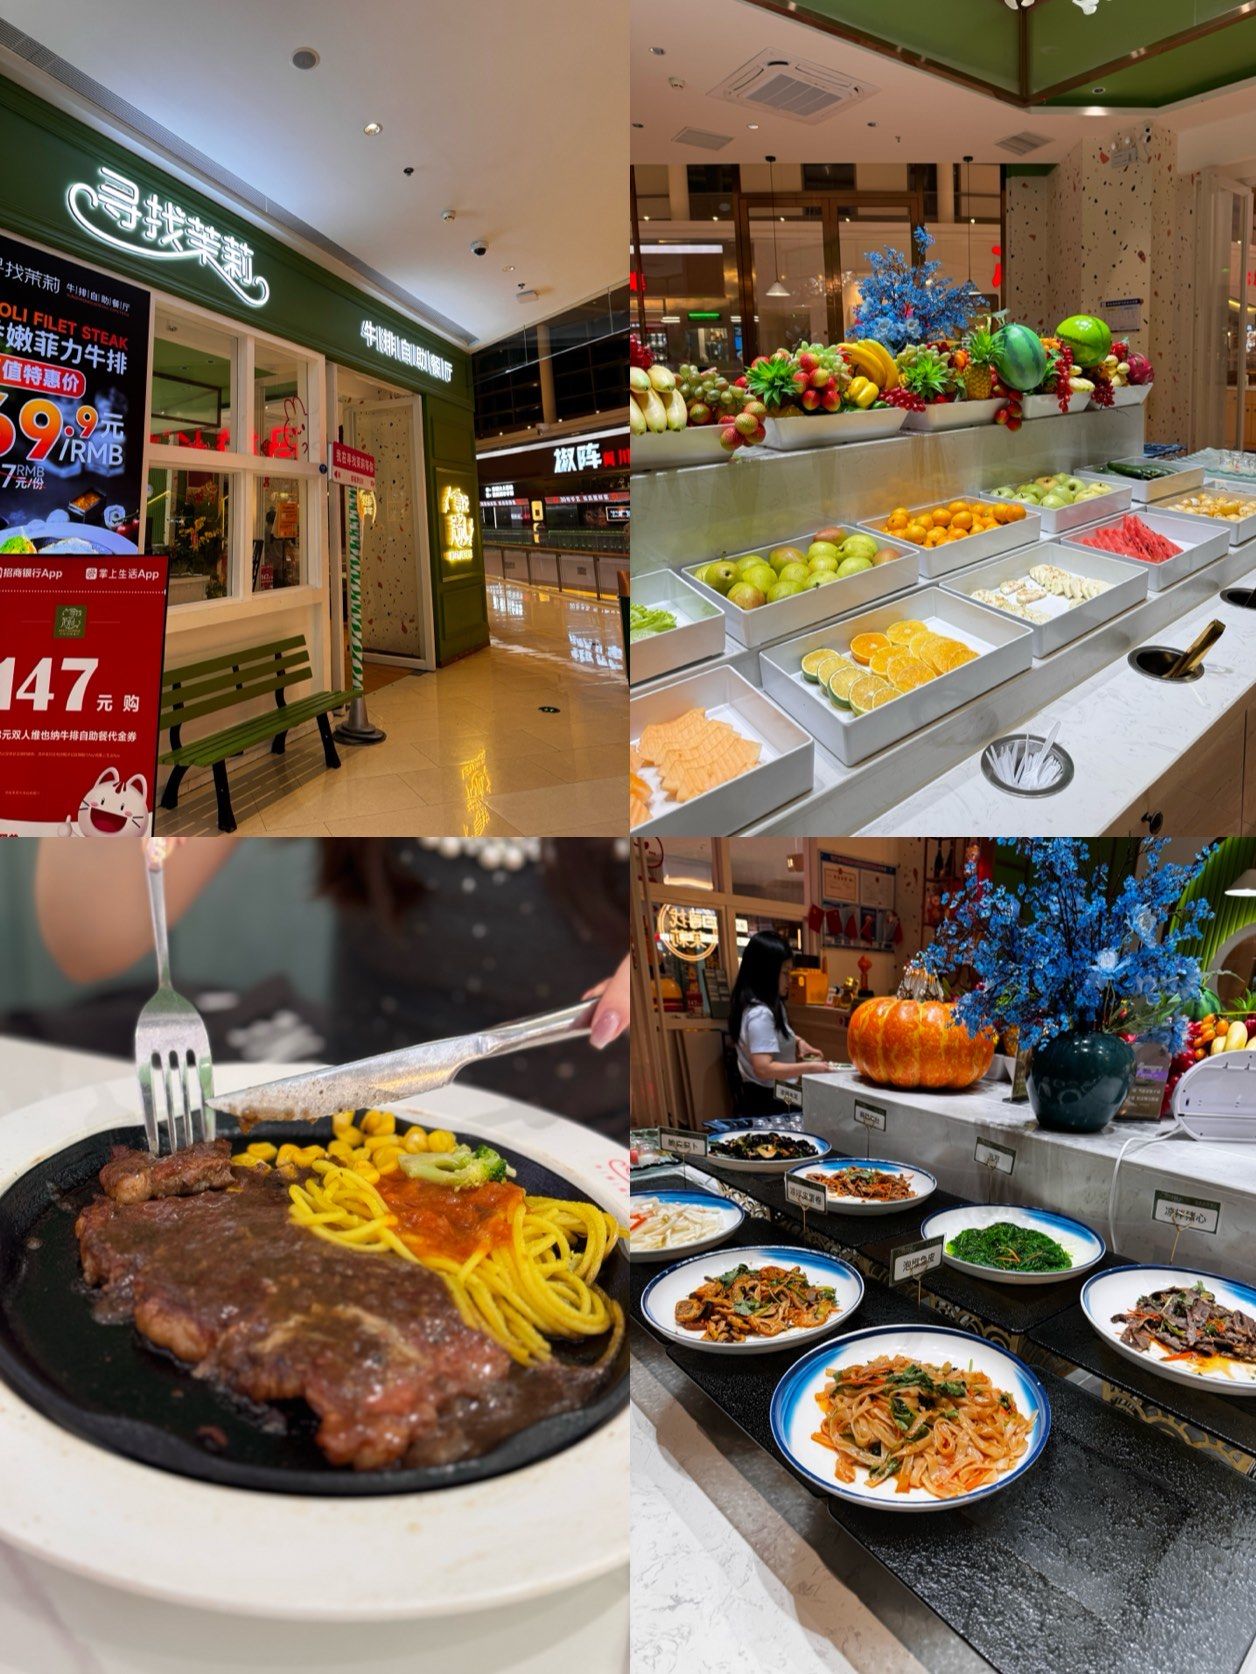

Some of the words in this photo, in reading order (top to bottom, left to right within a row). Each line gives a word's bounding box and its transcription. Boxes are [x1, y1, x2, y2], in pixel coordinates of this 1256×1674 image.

[90, 166, 257, 288] 寻找茉莉
[0, 257, 60, 294] 找茉莉
[0, 321, 128, 375] 嫩菲力牛排
[33, 311, 77, 336] FILET
[81, 325, 129, 351] STEAK
[3, 567, 63, 580] 招商银行App
[99, 568, 160, 580] 掌上生活App
